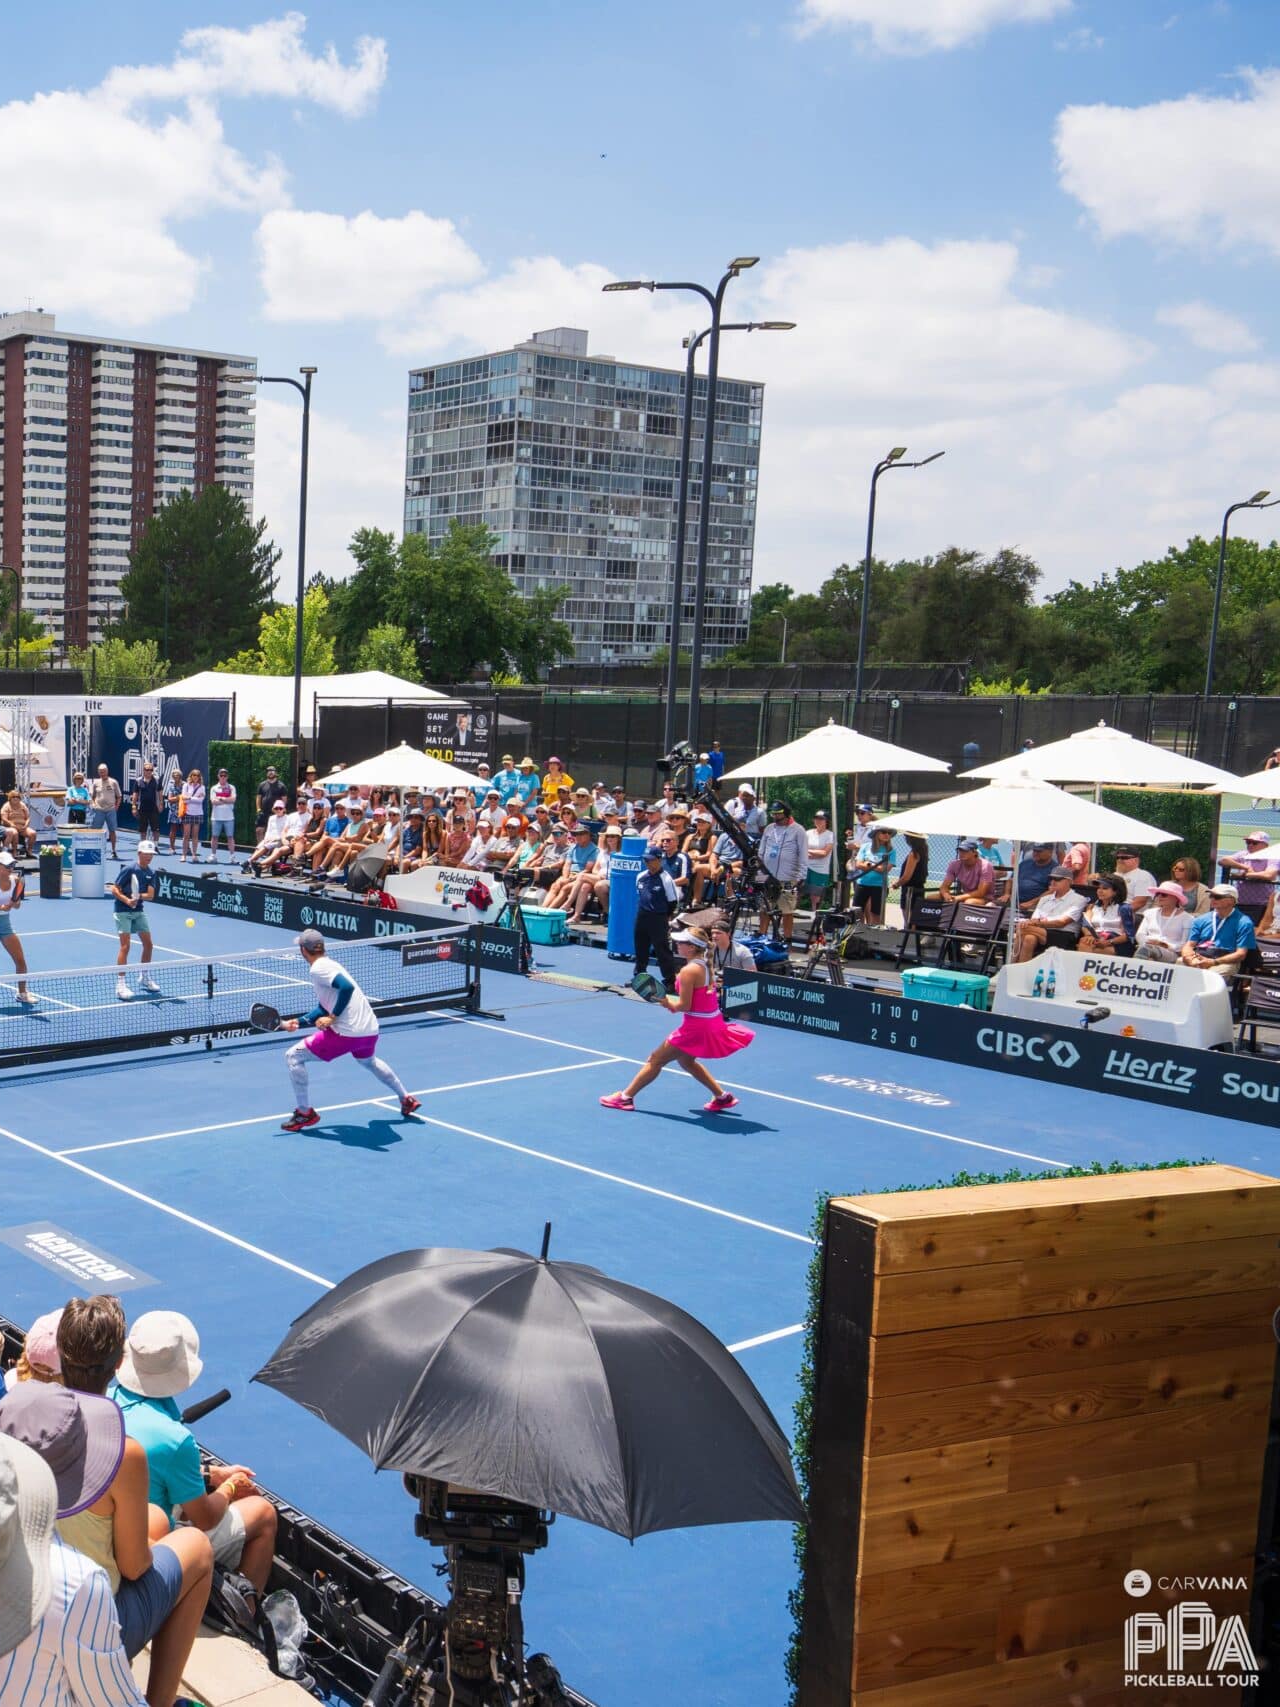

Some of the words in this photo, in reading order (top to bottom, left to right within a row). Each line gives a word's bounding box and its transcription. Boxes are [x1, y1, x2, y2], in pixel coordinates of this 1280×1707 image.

[85, 700, 103, 712] Lite
[891, 699, 900, 709] 9
[427, 713, 449, 721] GAME
[426, 725, 442, 733] SET
[425, 736, 454, 745] MATCH
[425, 748, 454, 762] SOLD
[172, 886, 202, 898] STORM
[264, 902, 283, 914] SOME
[264, 910, 283, 924] BAR
[315, 910, 358, 933] TAKEYA
[1083, 959, 1174, 984] Pickleball
[728, 989, 752, 1001] BAIRD
[1097, 978, 1164, 1001] Central
[767, 984, 795, 999] WATERS
[803, 991, 825, 1004] JOHNS
[871, 1002, 882, 1015] 11
[890, 1006, 901, 1019] 10
[912, 1009, 919, 1022] 0
[766, 1008, 796, 1023] BRASCIA
[803, 1015, 840, 1032] PATRIQUIN
[871, 1028, 878, 1041] 2
[890, 1032, 897, 1045] 5
[910, 1035, 917, 1048] 0
[189, 1028, 253, 1044] SELKIRK
[976, 1027, 1046, 1062] CIBC
[1104, 1048, 1197, 1088] Hertz
[1222, 1072, 1280, 1103] Sou
[25, 1231, 136, 1282] ACRYTECH
[510, 1579, 518, 1591] 5
